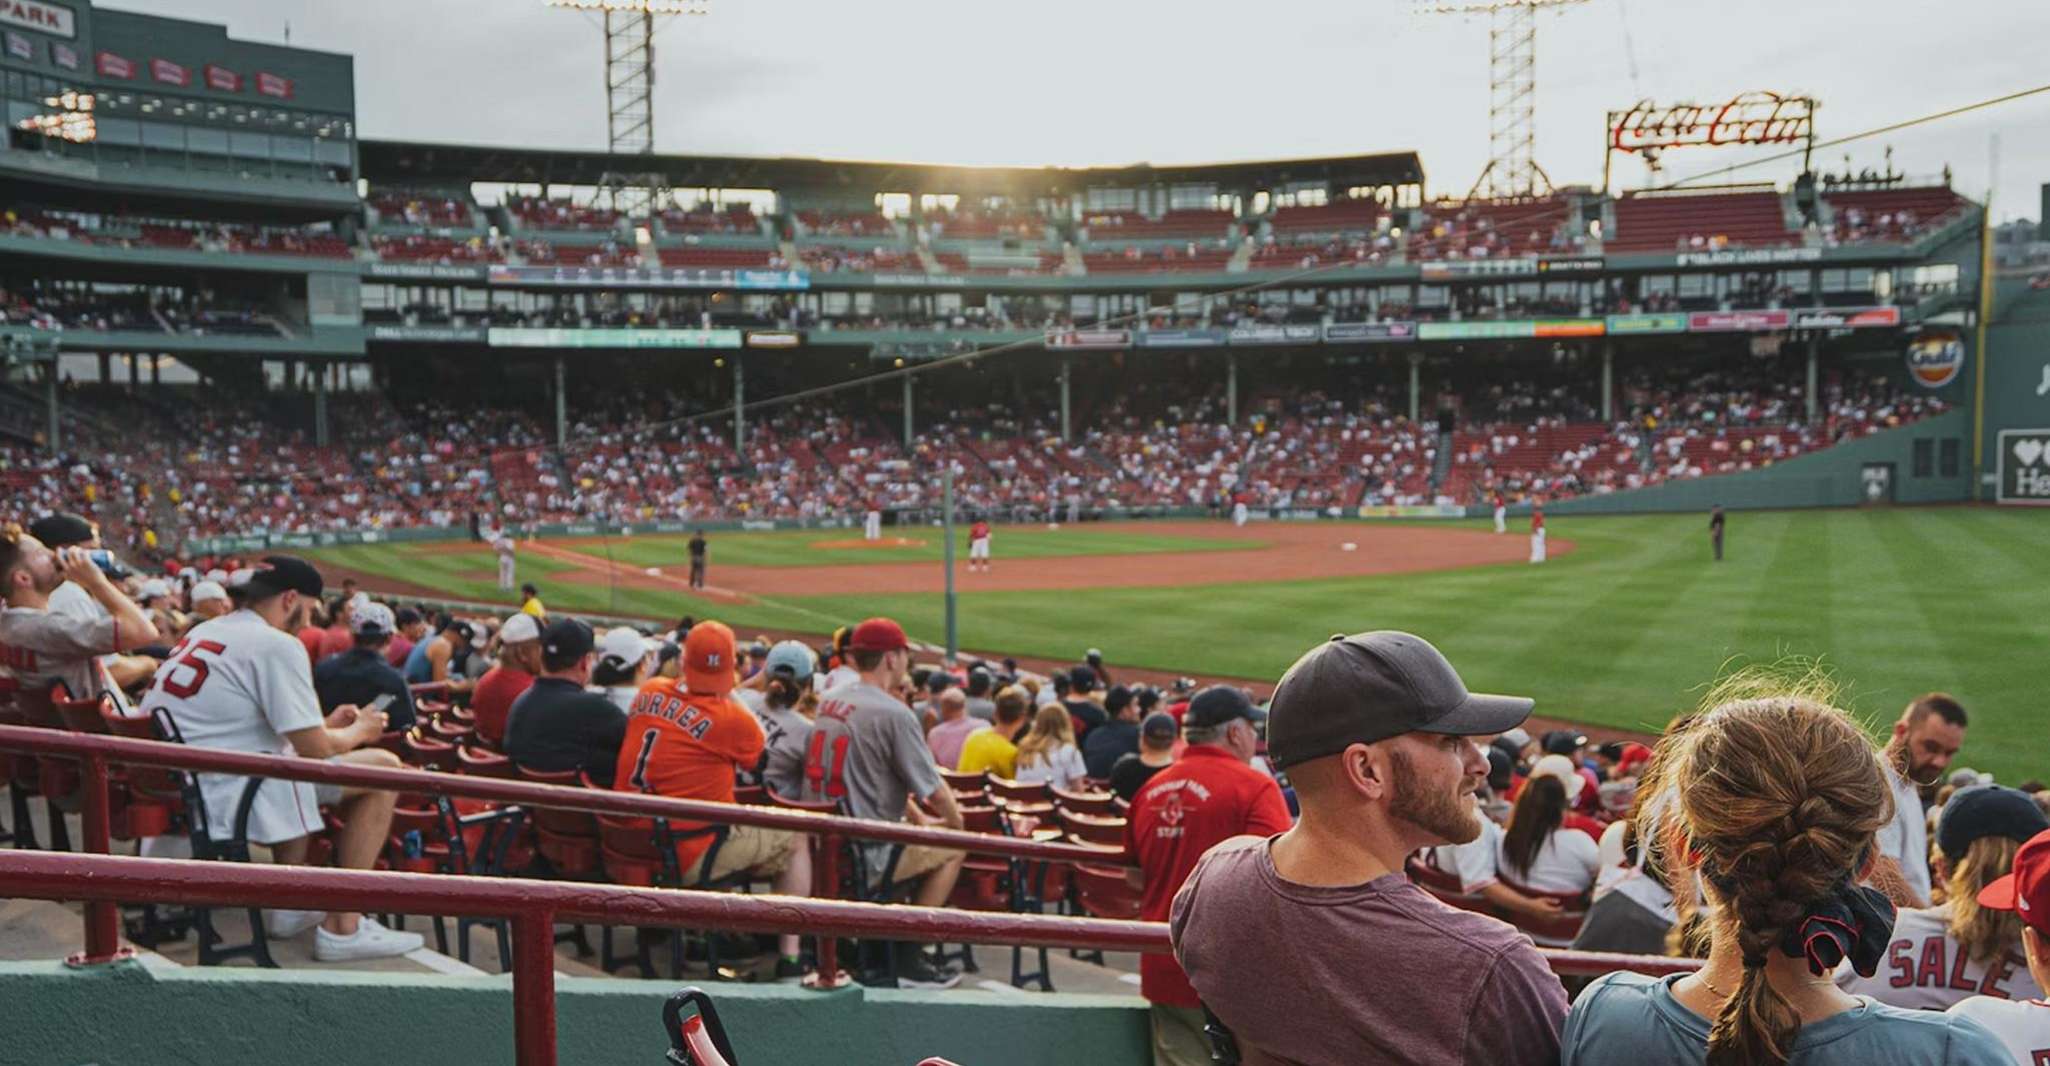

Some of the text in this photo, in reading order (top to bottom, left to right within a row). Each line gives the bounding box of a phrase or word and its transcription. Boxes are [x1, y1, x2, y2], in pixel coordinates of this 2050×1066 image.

[0, 0, 60, 28] PARK
[1614, 92, 1808, 153] Coca-Cola
[629, 728, 660, 789] 1
[805, 730, 850, 798] 41
[1888, 935, 2028, 1000] SALE
